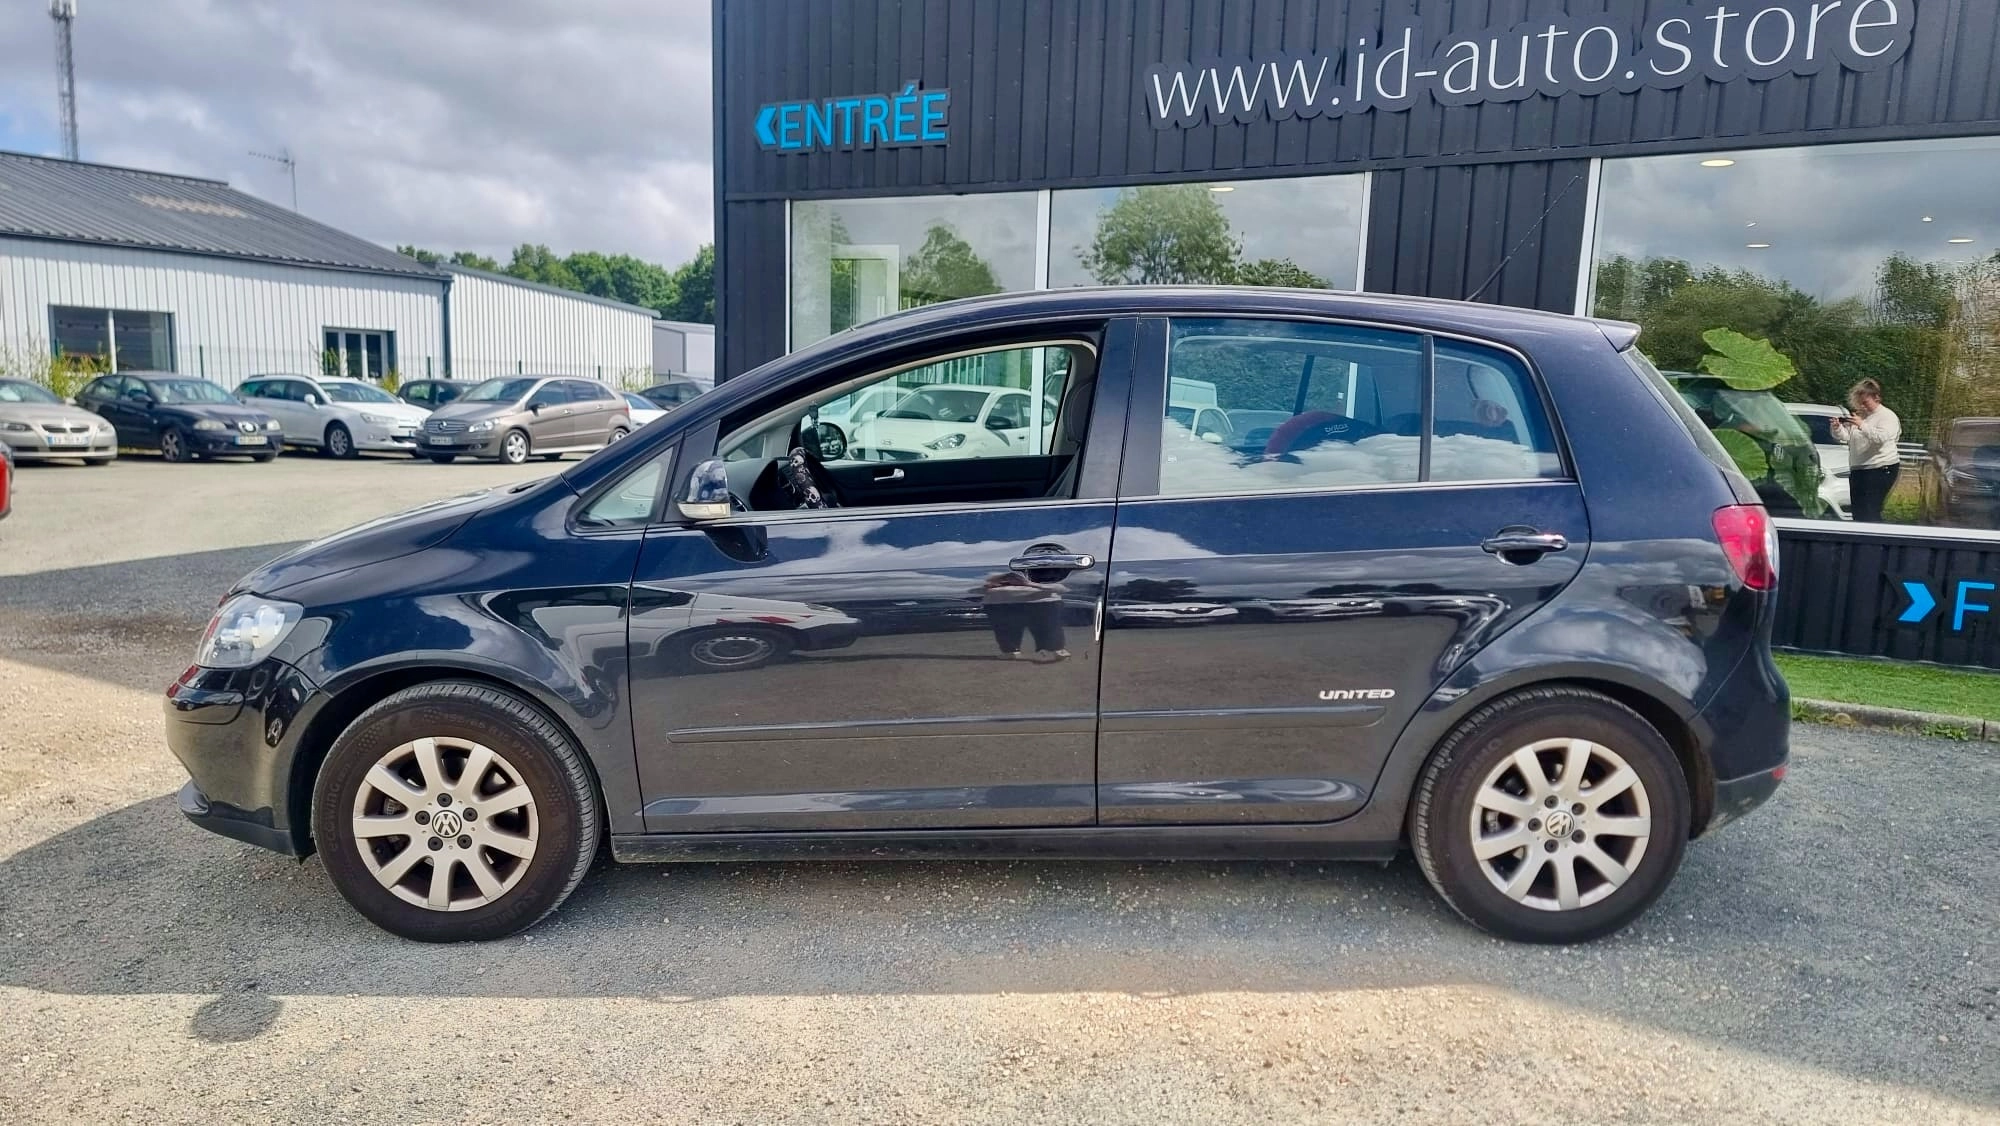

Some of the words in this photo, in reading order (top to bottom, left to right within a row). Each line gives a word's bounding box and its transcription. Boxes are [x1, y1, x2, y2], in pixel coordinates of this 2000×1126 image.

[1153, 0, 1898, 119] www.id-auto.store
[780, 84, 947, 149] ENTRÉE
[1953, 581, 1995, 631] F
[1318, 688, 1396, 700] UNITED
